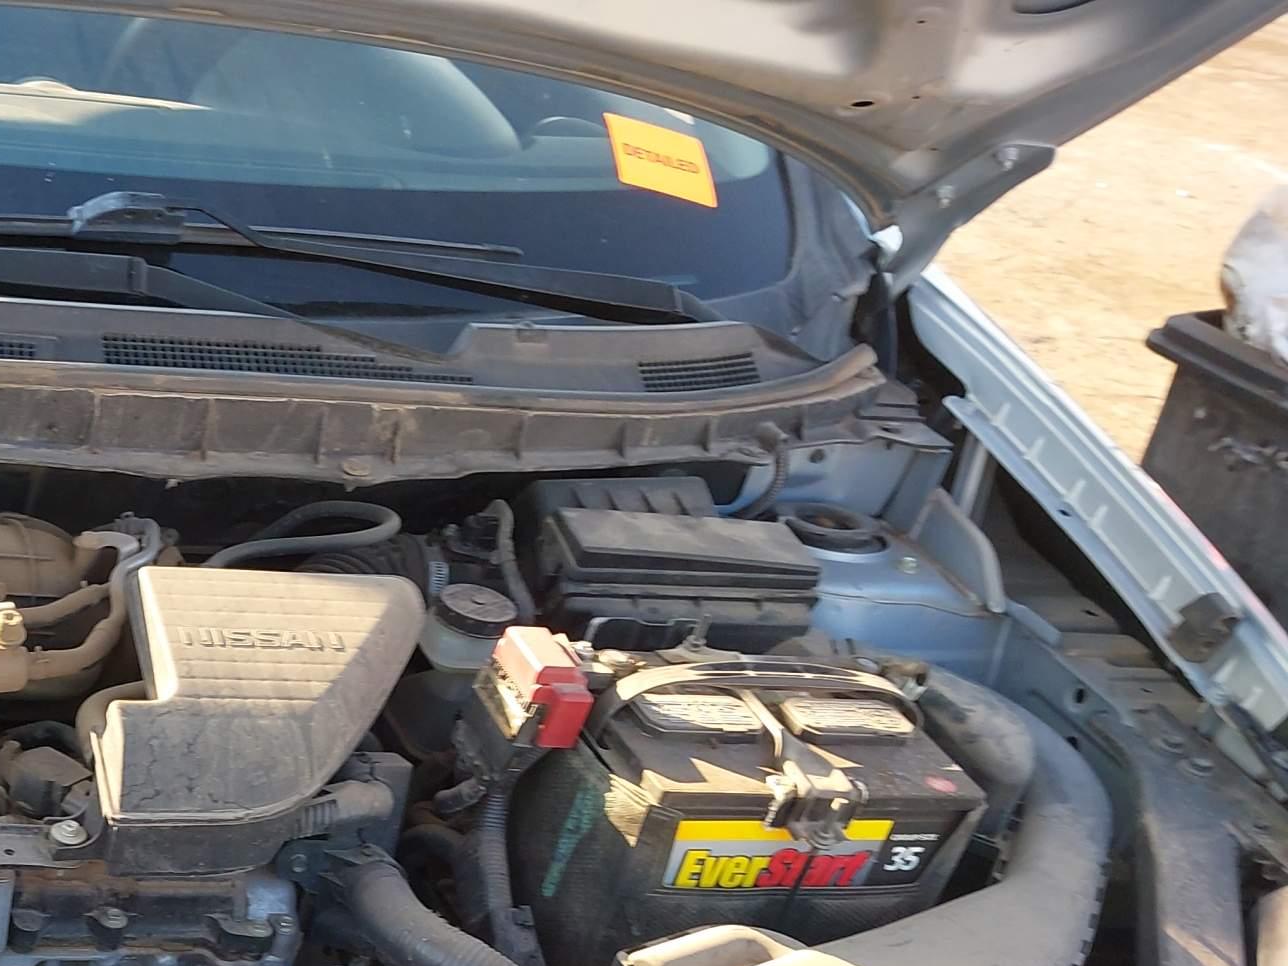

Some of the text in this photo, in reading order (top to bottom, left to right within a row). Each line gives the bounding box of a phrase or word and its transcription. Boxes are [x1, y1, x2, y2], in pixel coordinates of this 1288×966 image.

[622, 143, 699, 174] DETAILED
[177, 626, 346, 652] NISSAN
[675, 848, 871, 888] EverStart
[883, 846, 926, 871] 35
